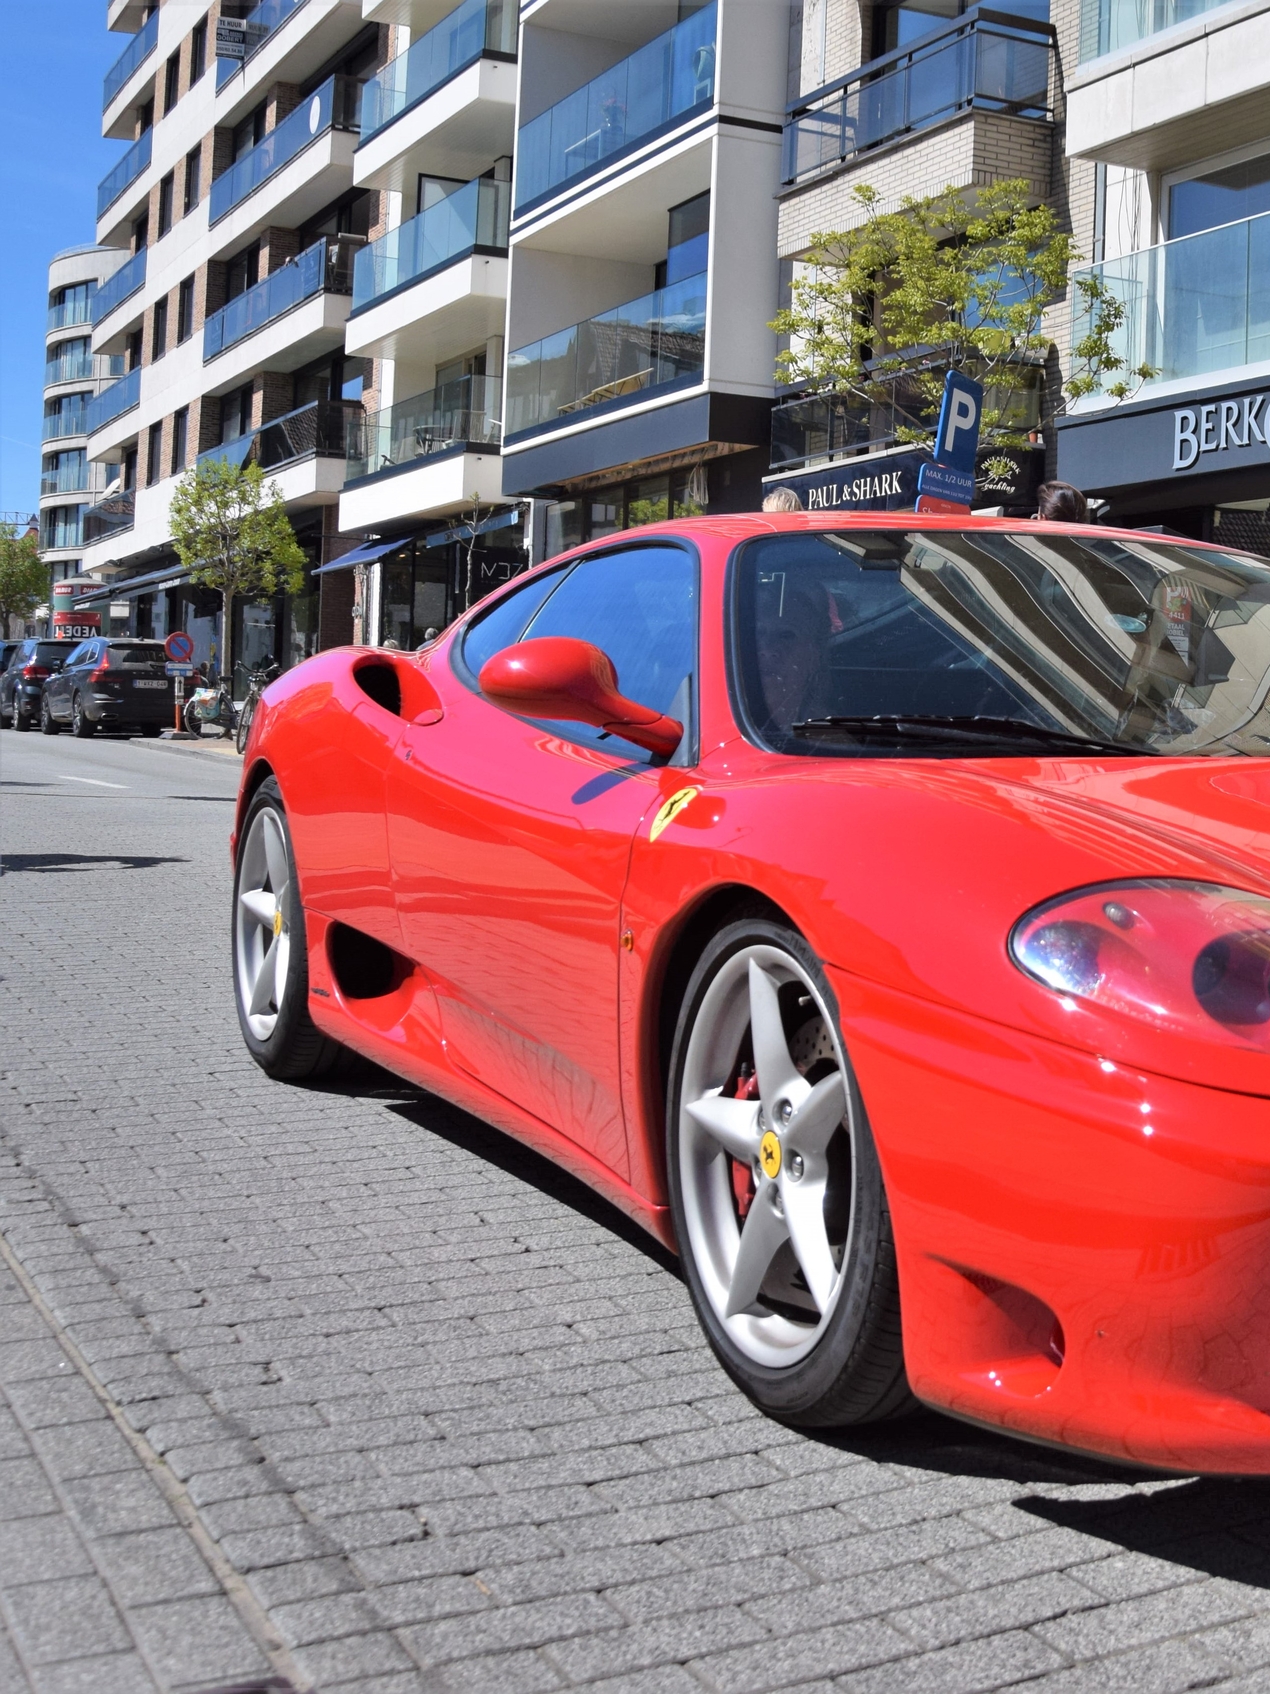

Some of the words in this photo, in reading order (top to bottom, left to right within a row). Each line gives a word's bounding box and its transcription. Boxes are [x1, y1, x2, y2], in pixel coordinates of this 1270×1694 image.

[945, 387, 977, 452] P
[808, 484, 841, 510] PAUL
[842, 486, 851, 501] &
[852, 471, 902, 501] SHARK
[925, 469, 944, 481] MAX.
[945, 475, 956, 484] 1/2
[957, 478, 973, 488] UUR
[981, 481, 1016, 495] yachting
